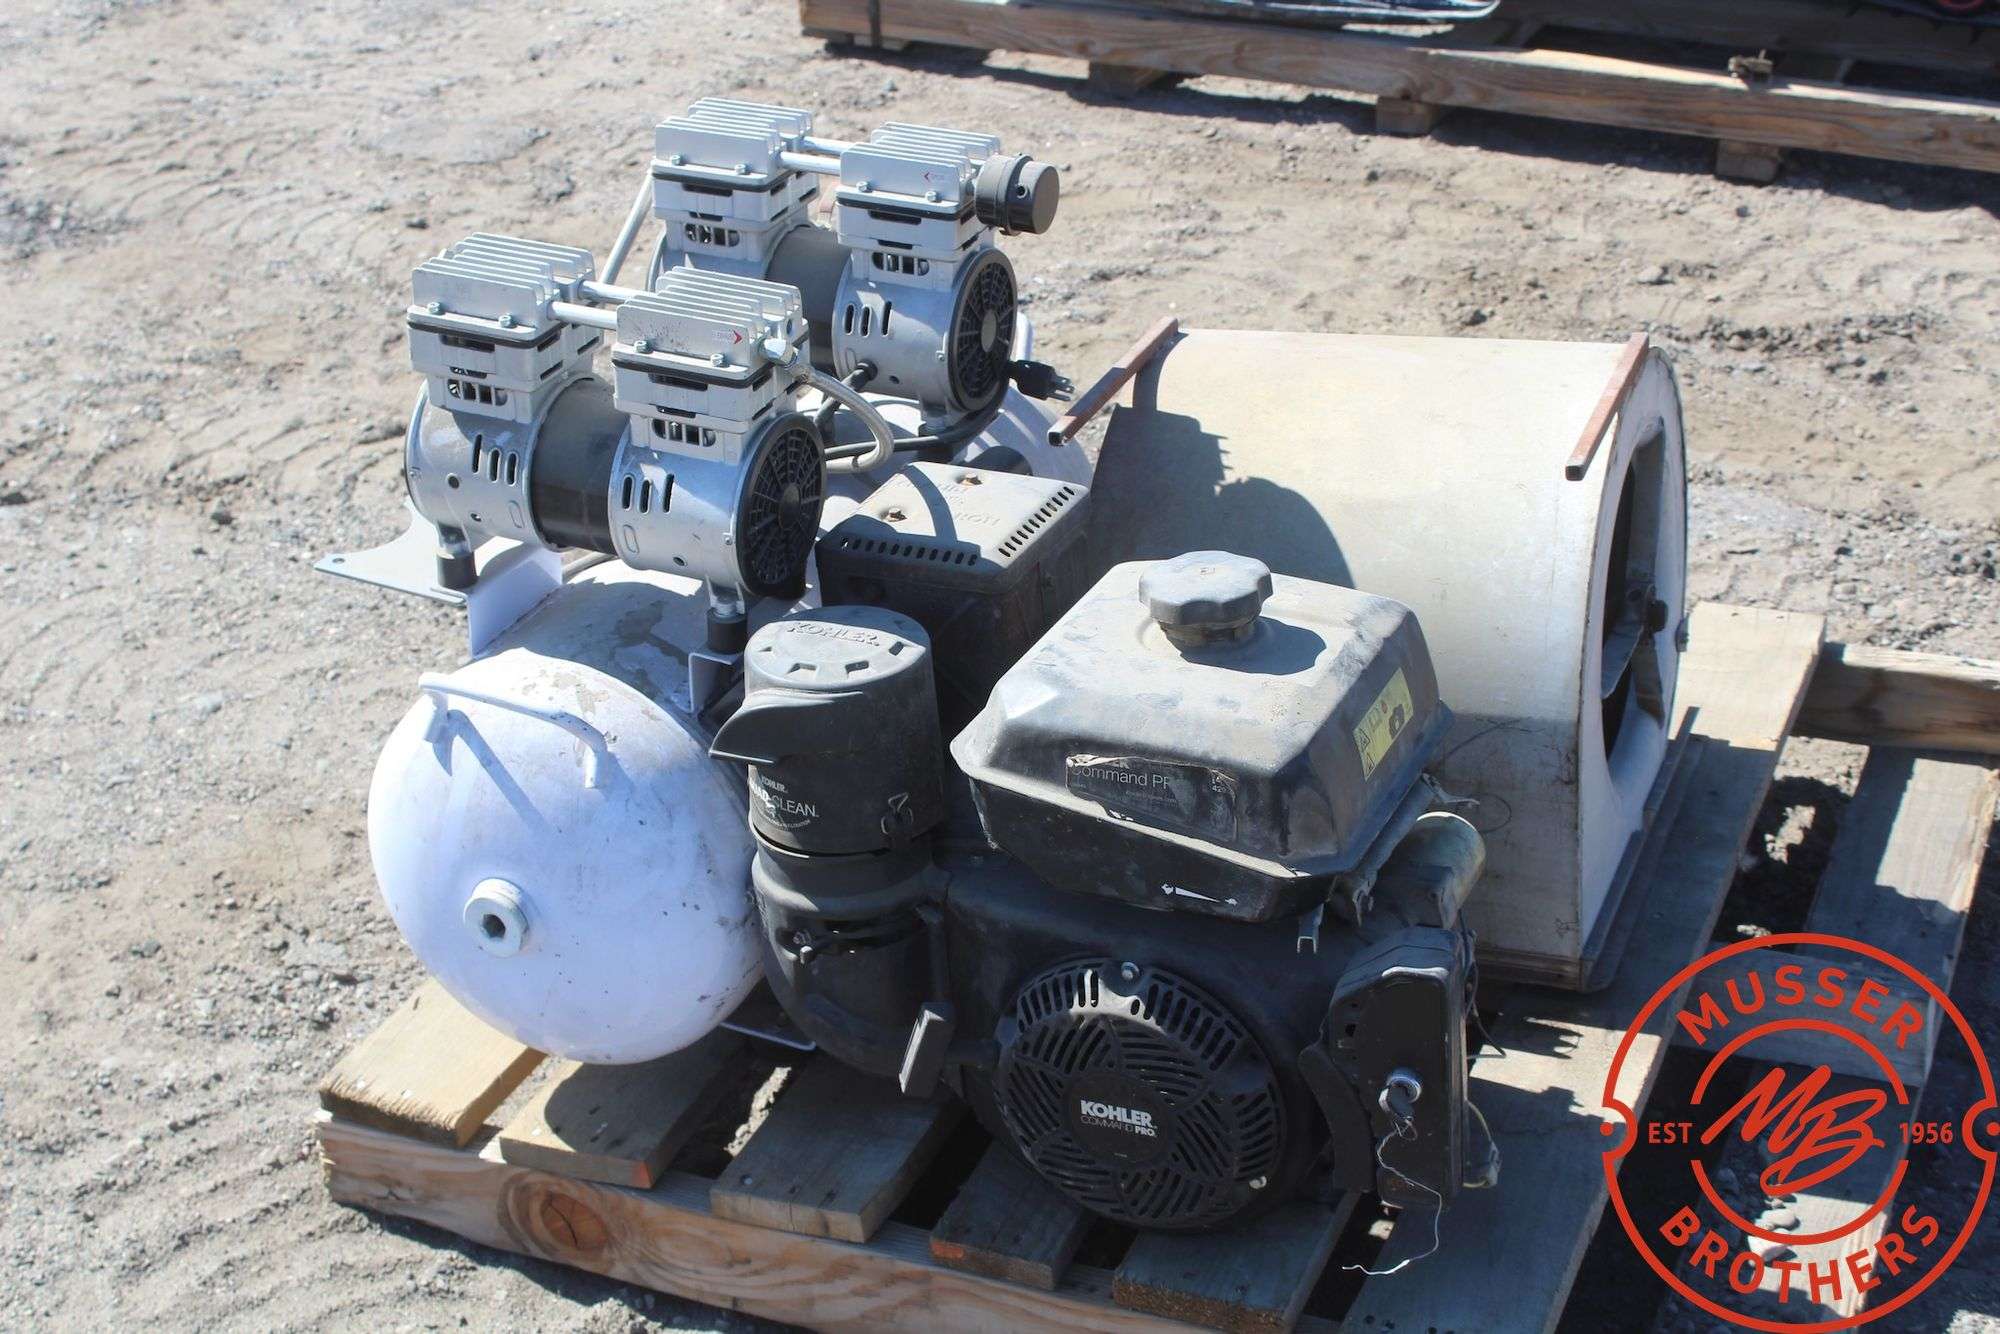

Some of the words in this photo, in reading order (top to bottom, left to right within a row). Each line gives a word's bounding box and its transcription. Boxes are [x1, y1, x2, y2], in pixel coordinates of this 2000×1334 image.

[1071, 763, 1148, 786] Command
[1080, 1099, 1154, 1128] KOHLER
[1080, 1115, 1134, 1133] COMMAND
[1135, 1125, 1155, 1137] PRO
